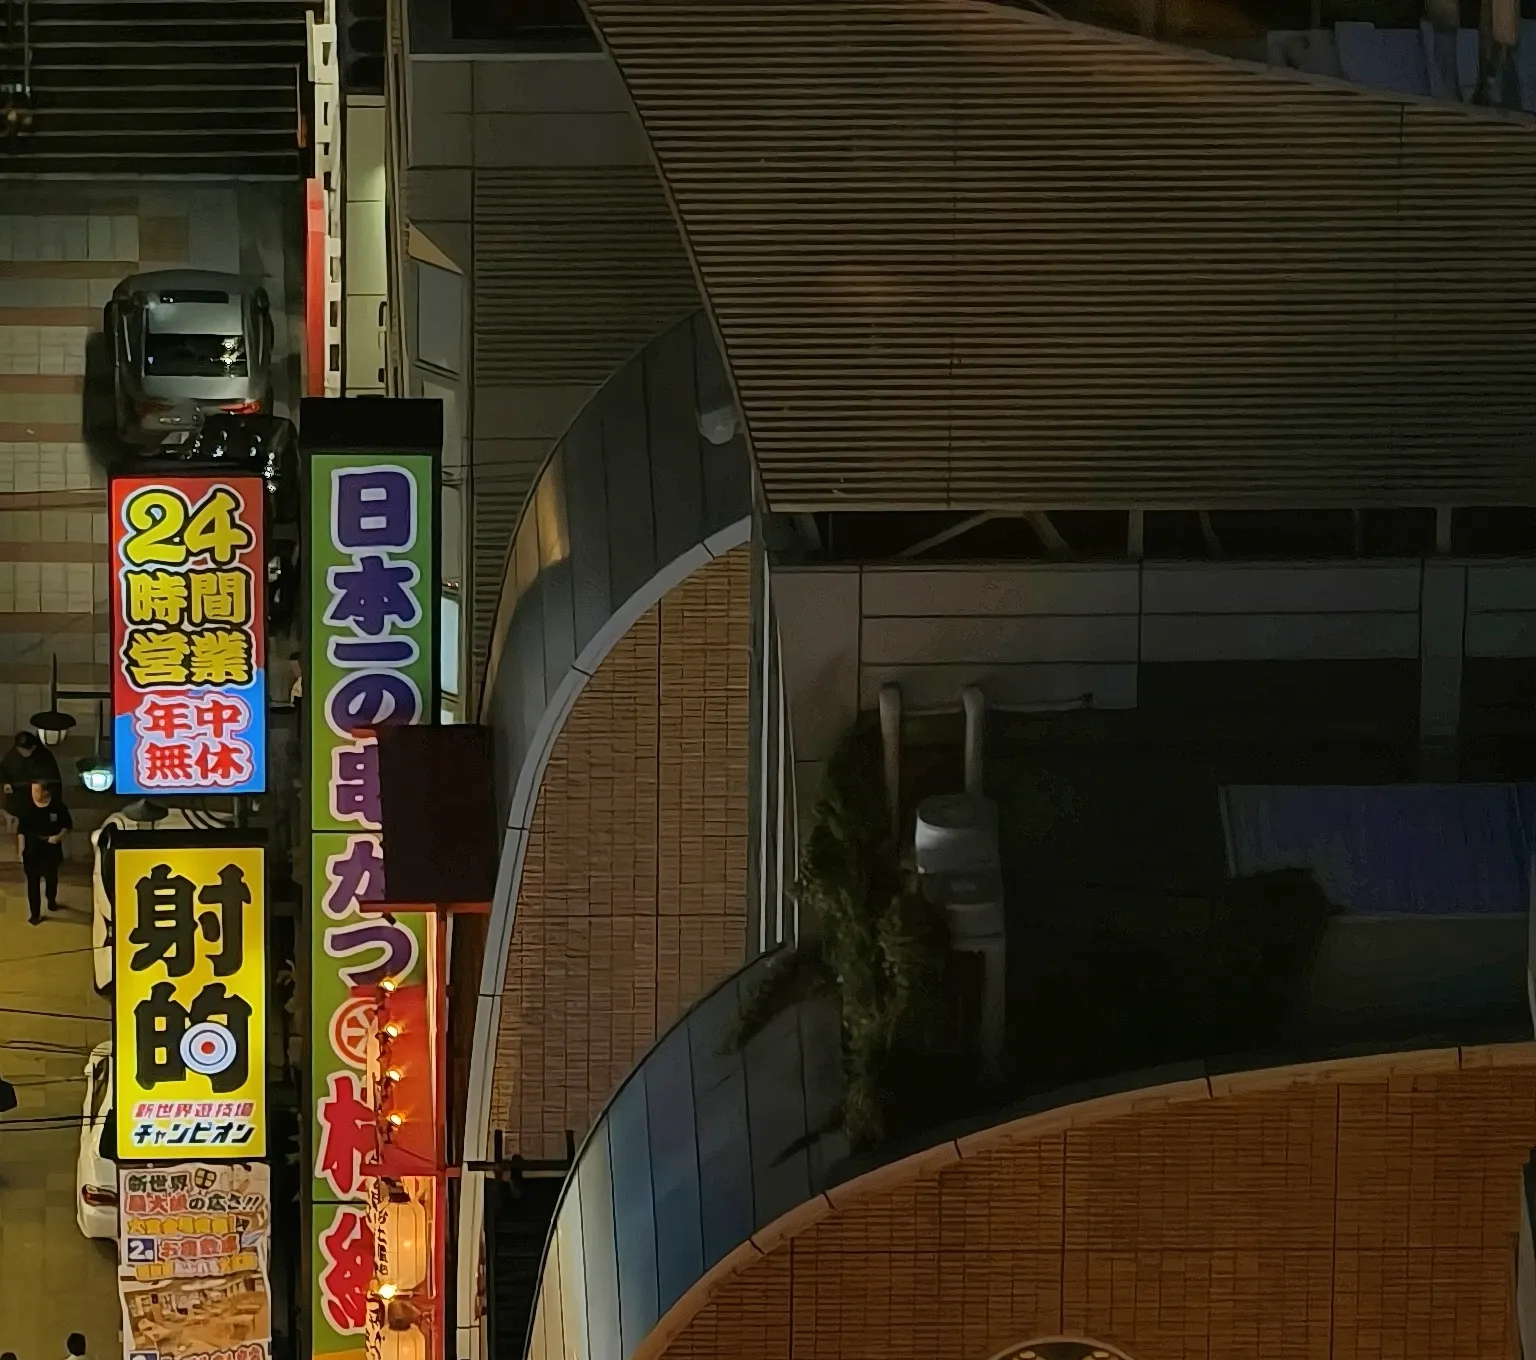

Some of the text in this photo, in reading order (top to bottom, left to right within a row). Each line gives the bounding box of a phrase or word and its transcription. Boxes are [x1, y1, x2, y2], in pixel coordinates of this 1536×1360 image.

[126, 489, 252, 565] 24
[128, 570, 252, 626] 時間
[128, 630, 252, 685] 営業
[143, 698, 243, 741] 年中
[143, 742, 247, 783] 無休
[128, 863, 253, 1095] 射的
[133, 1121, 255, 1144] チャンピオン
